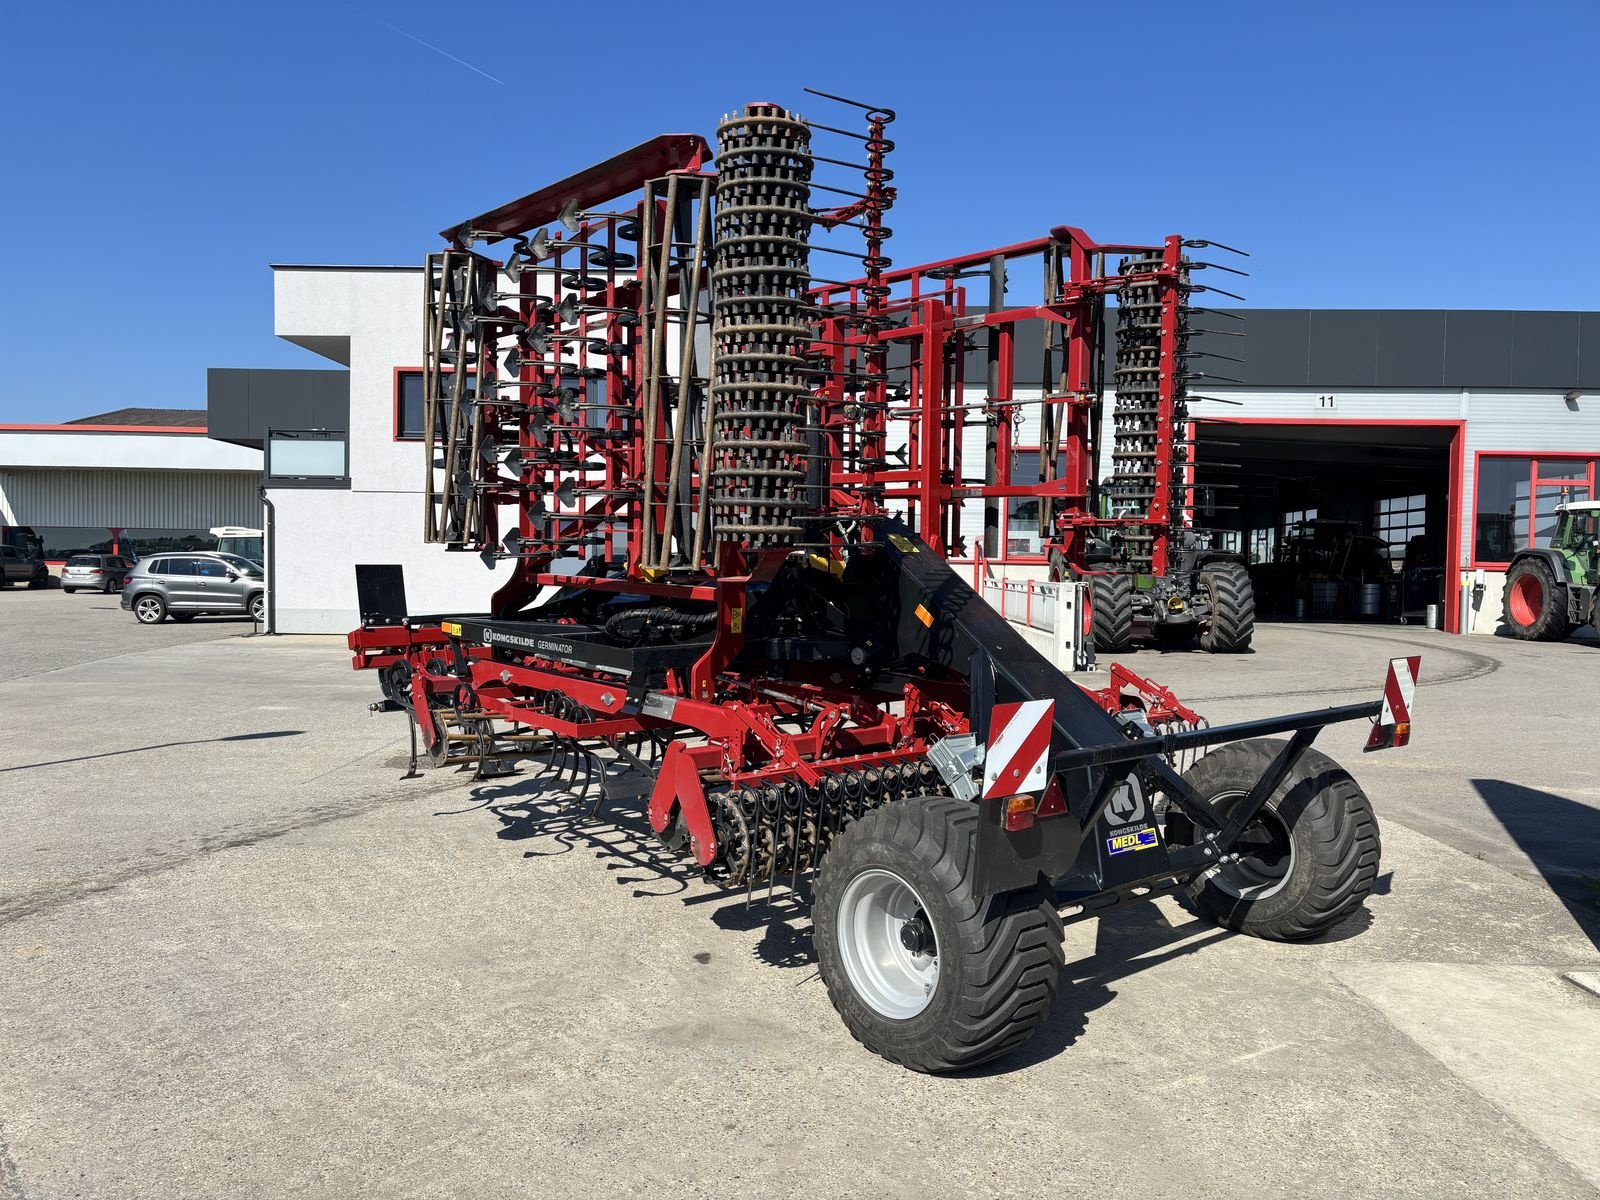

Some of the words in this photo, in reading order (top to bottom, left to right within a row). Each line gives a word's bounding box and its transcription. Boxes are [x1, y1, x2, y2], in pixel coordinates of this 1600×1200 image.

[1319, 395, 1334, 408] 11
[492, 632, 535, 647] KONGSKILDE
[537, 640, 573, 654] GERMINATOR
[1109, 823, 1149, 837] KONGSKILDE
[1112, 834, 1142, 850] MEDL
